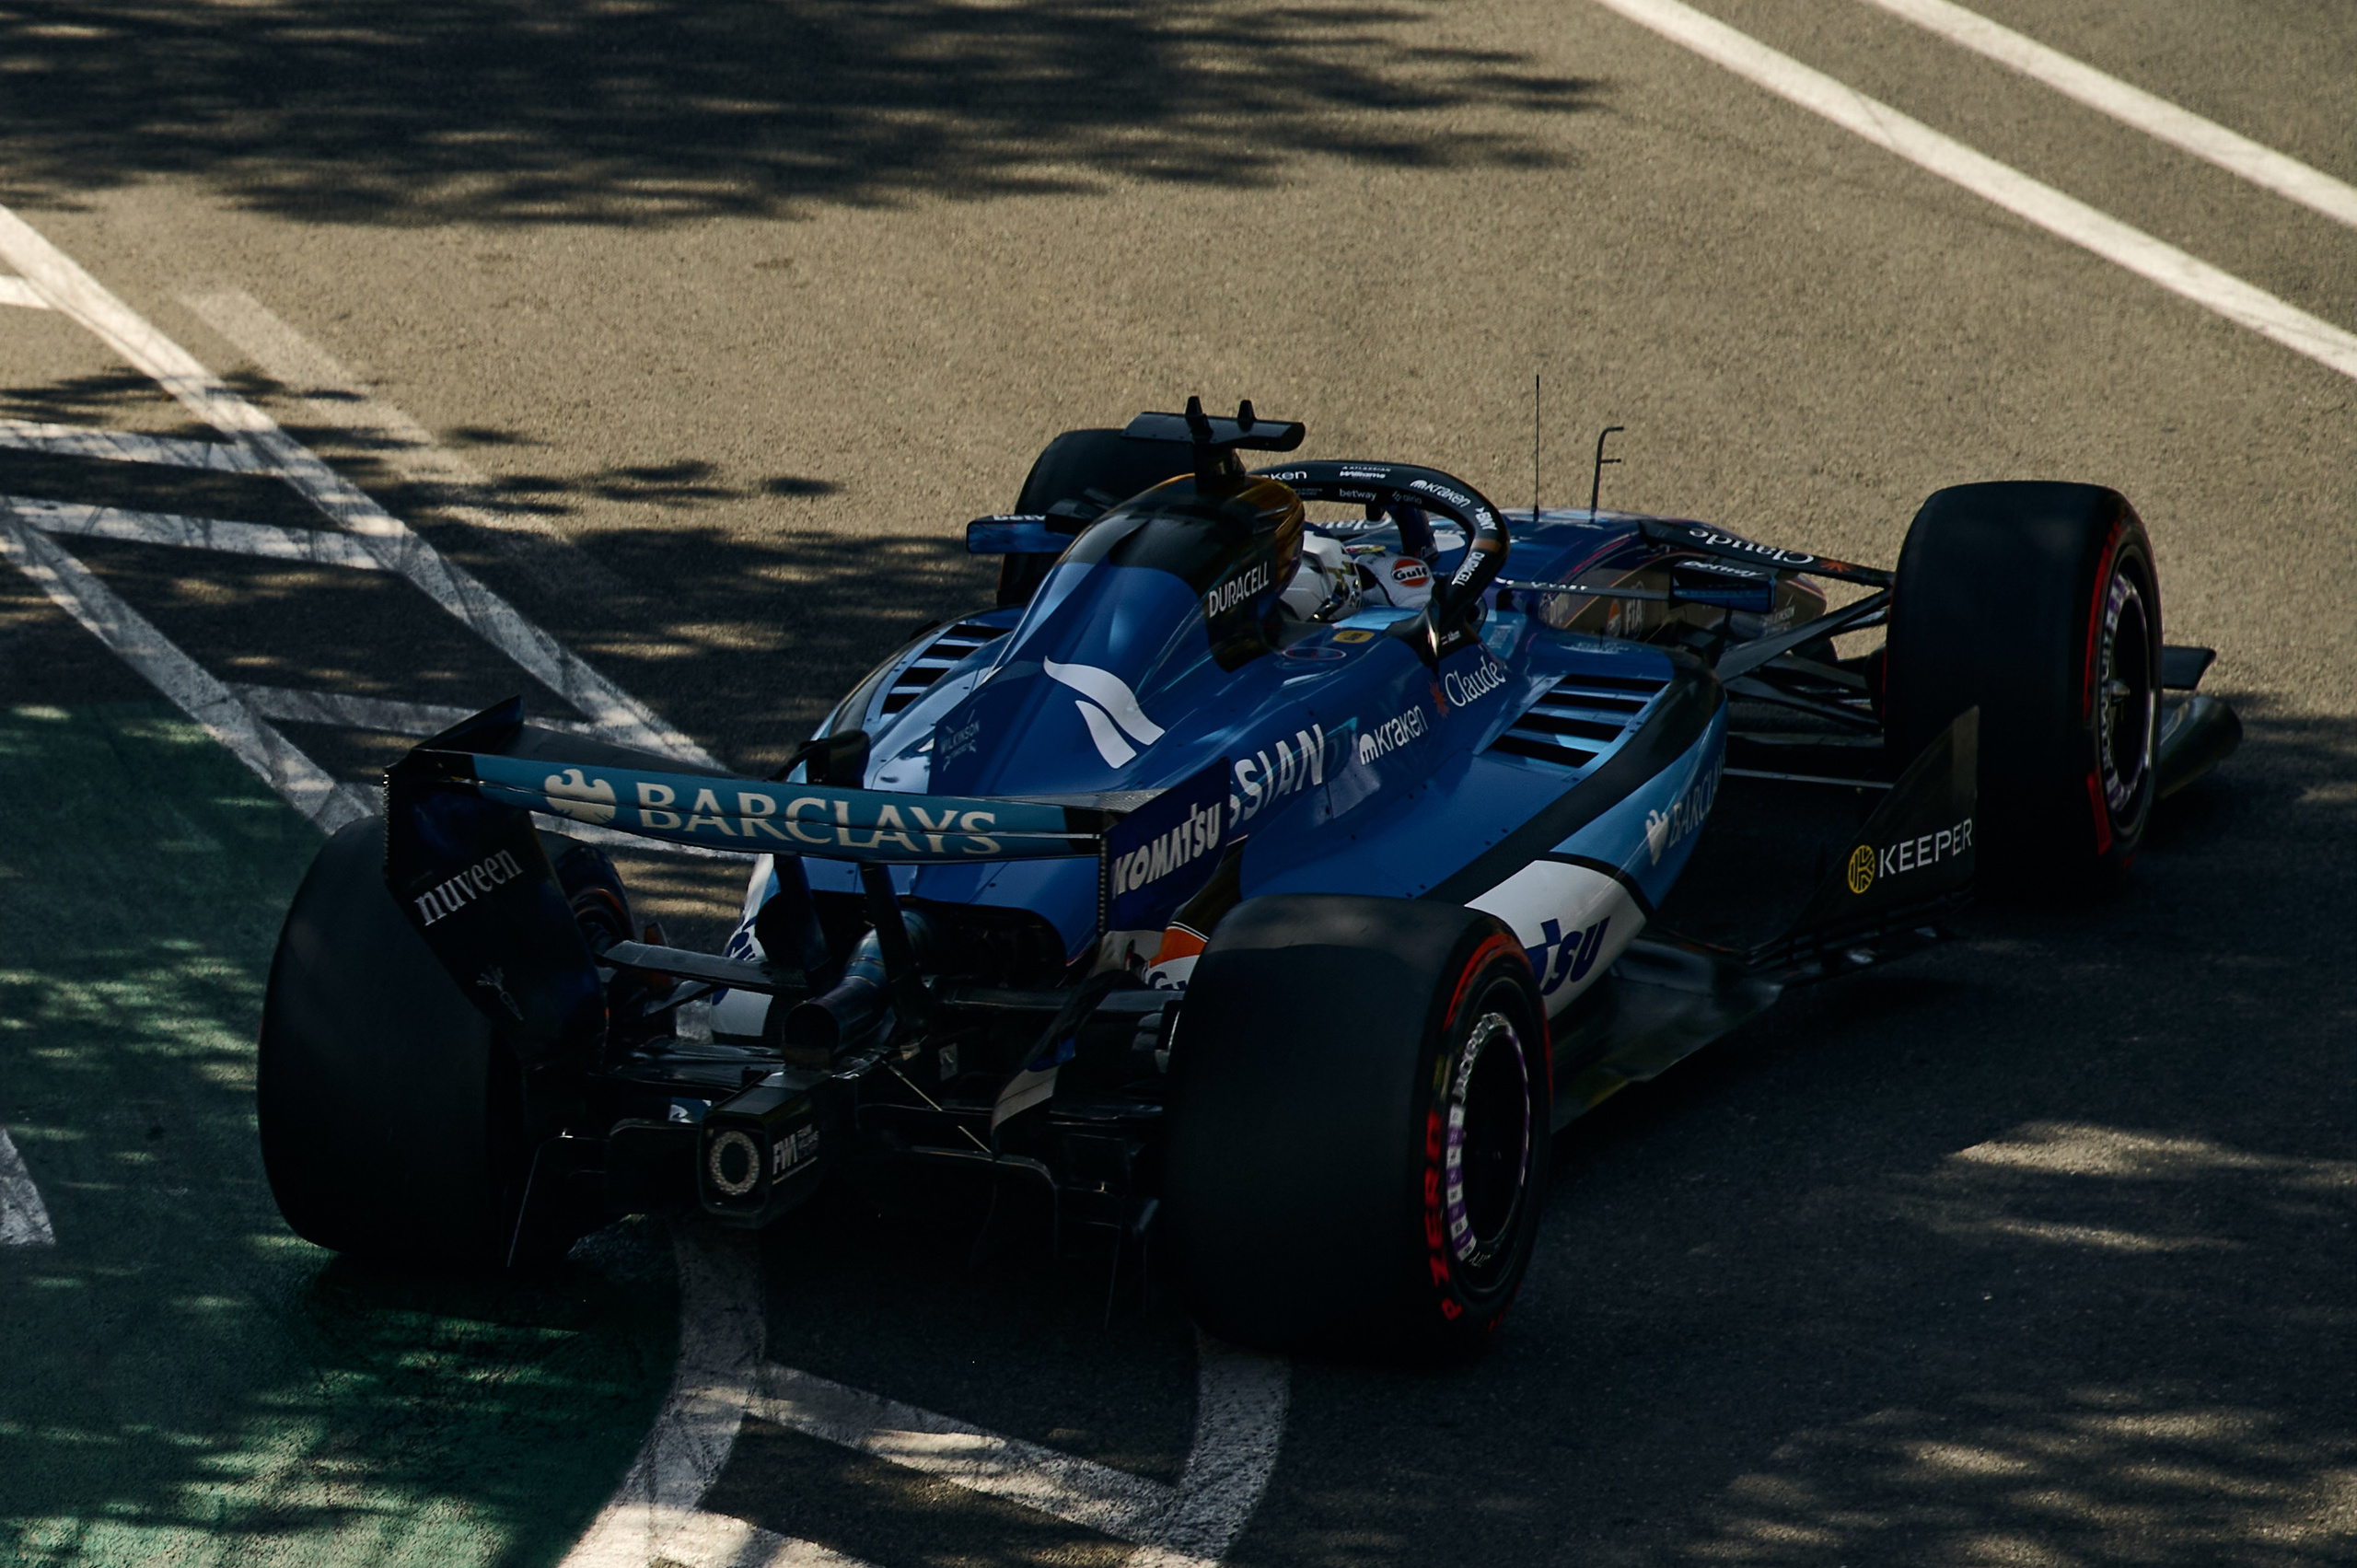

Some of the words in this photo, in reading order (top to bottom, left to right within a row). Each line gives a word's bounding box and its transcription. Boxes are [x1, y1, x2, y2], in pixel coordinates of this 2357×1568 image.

[1339, 488, 1377, 502] betway
[1209, 560, 1270, 619] DURACELL
[1393, 567, 1428, 581] Gulf
[1445, 655, 1506, 707] Claude
[635, 781, 1003, 856] BARCLAYS
[1879, 818, 1972, 878] KEEPER
[1110, 802, 1222, 900] KOMATSU
[414, 849, 524, 926] nuveen
